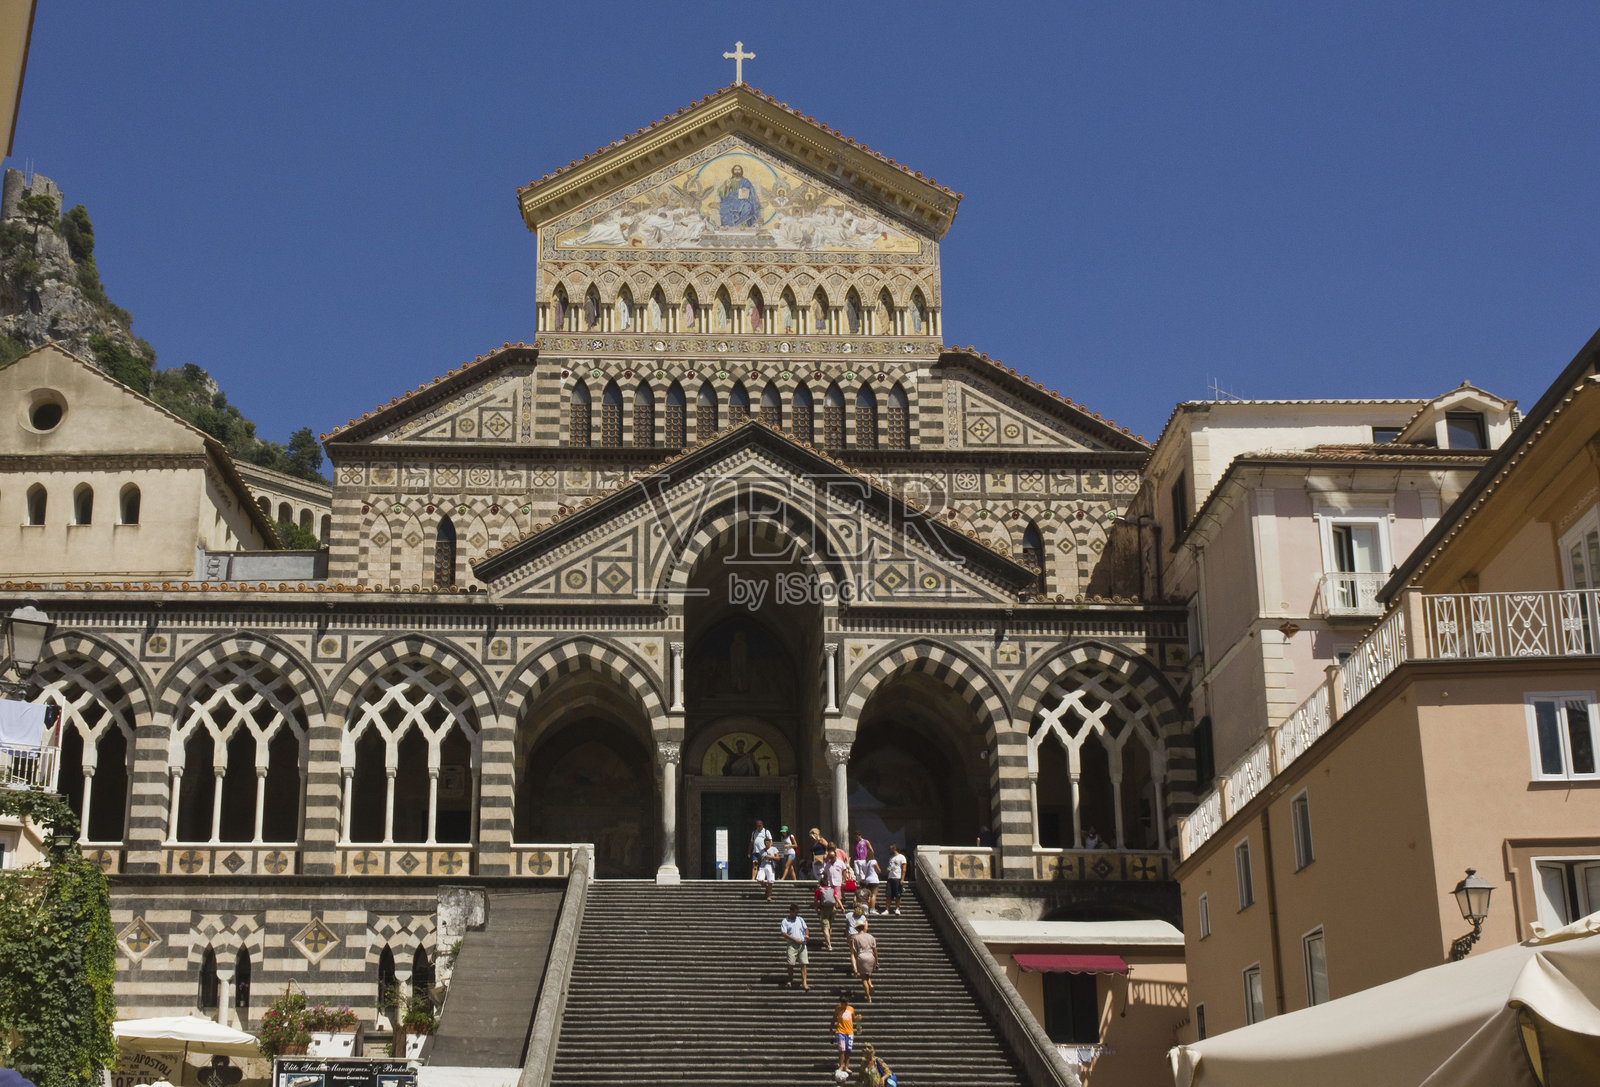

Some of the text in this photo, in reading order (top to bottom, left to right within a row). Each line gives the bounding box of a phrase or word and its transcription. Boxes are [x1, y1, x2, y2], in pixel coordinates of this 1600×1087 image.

[133, 1053, 172, 1077] APOSTOLI
[283, 1062, 299, 1071] Elite
[301, 1062, 322, 1072] Yach
[327, 1063, 370, 1075] Managemen
